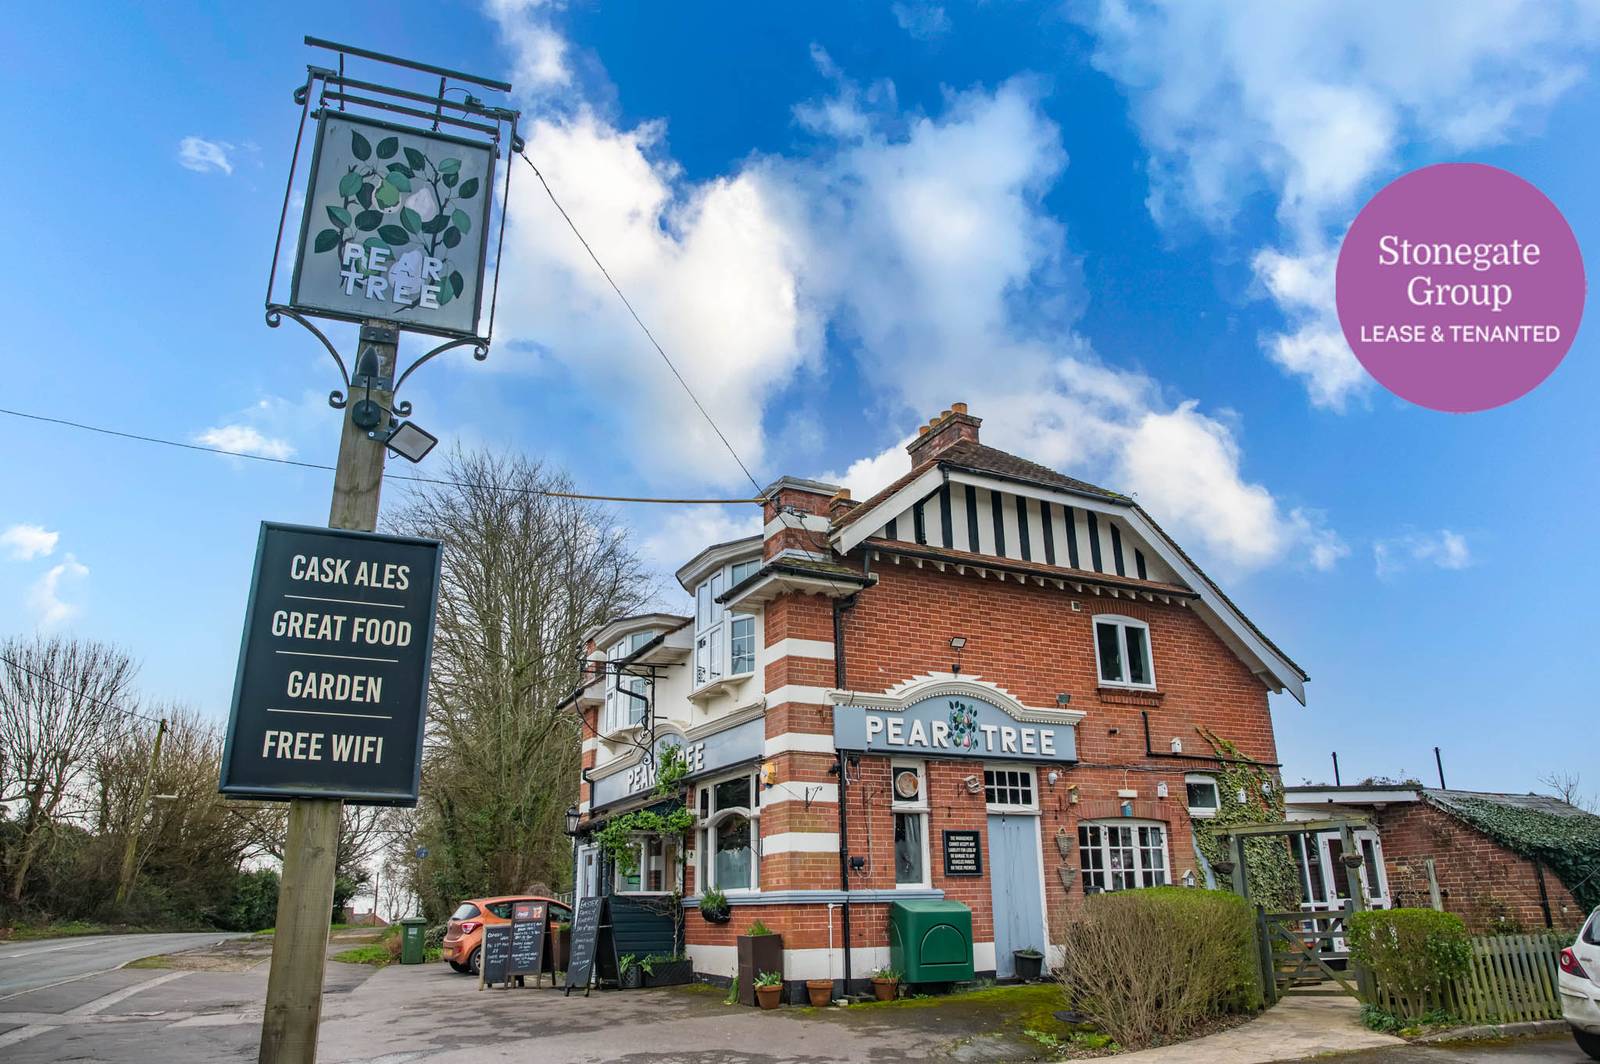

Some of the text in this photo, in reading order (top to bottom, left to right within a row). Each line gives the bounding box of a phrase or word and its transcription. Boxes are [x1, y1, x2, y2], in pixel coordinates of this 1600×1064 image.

[342, 242, 443, 281] PEAR
[340, 271, 441, 309] TREE
[290, 554, 411, 591] CASK ALES
[271, 610, 412, 647] GREAT FOOD
[287, 670, 383, 703] GARDEN
[262, 730, 384, 764] FREE WIFI
[865, 715, 1057, 756] PEAR TREE
